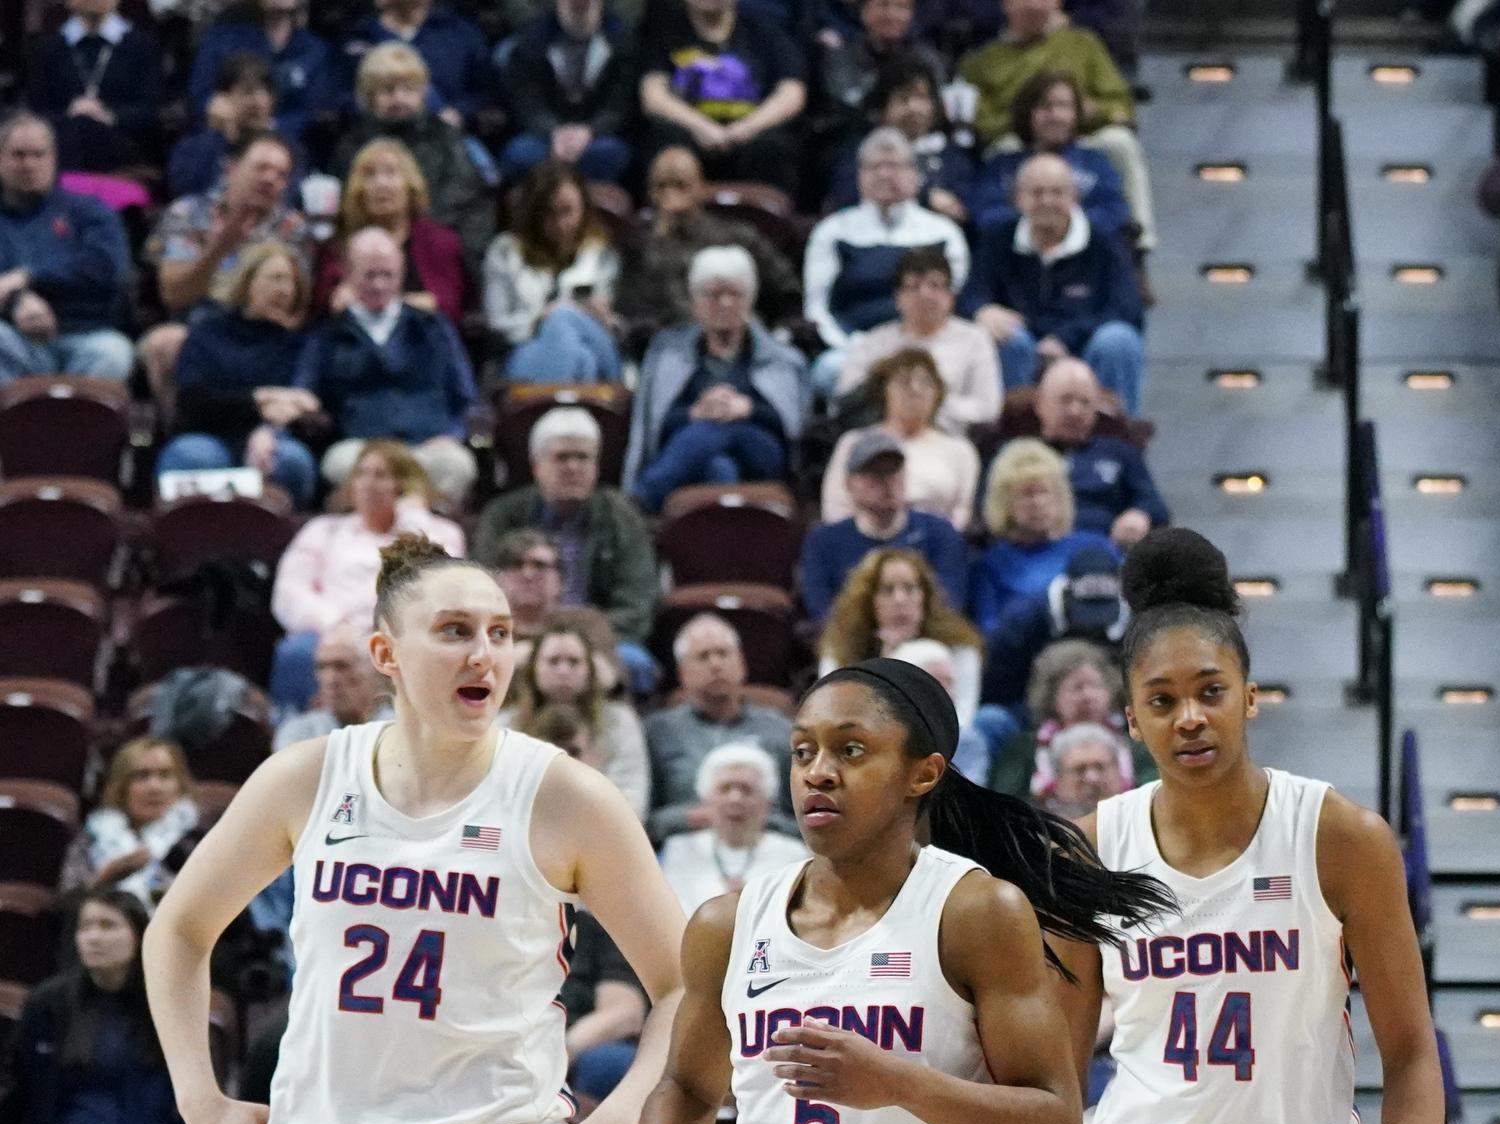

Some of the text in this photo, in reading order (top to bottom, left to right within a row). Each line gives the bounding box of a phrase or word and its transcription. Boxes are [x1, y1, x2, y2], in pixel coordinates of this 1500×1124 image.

[312, 860, 500, 918] UCONN
[338, 924, 446, 1021] 24
[1120, 929, 1299, 981] UCONN
[1163, 991, 1255, 1081] 44
